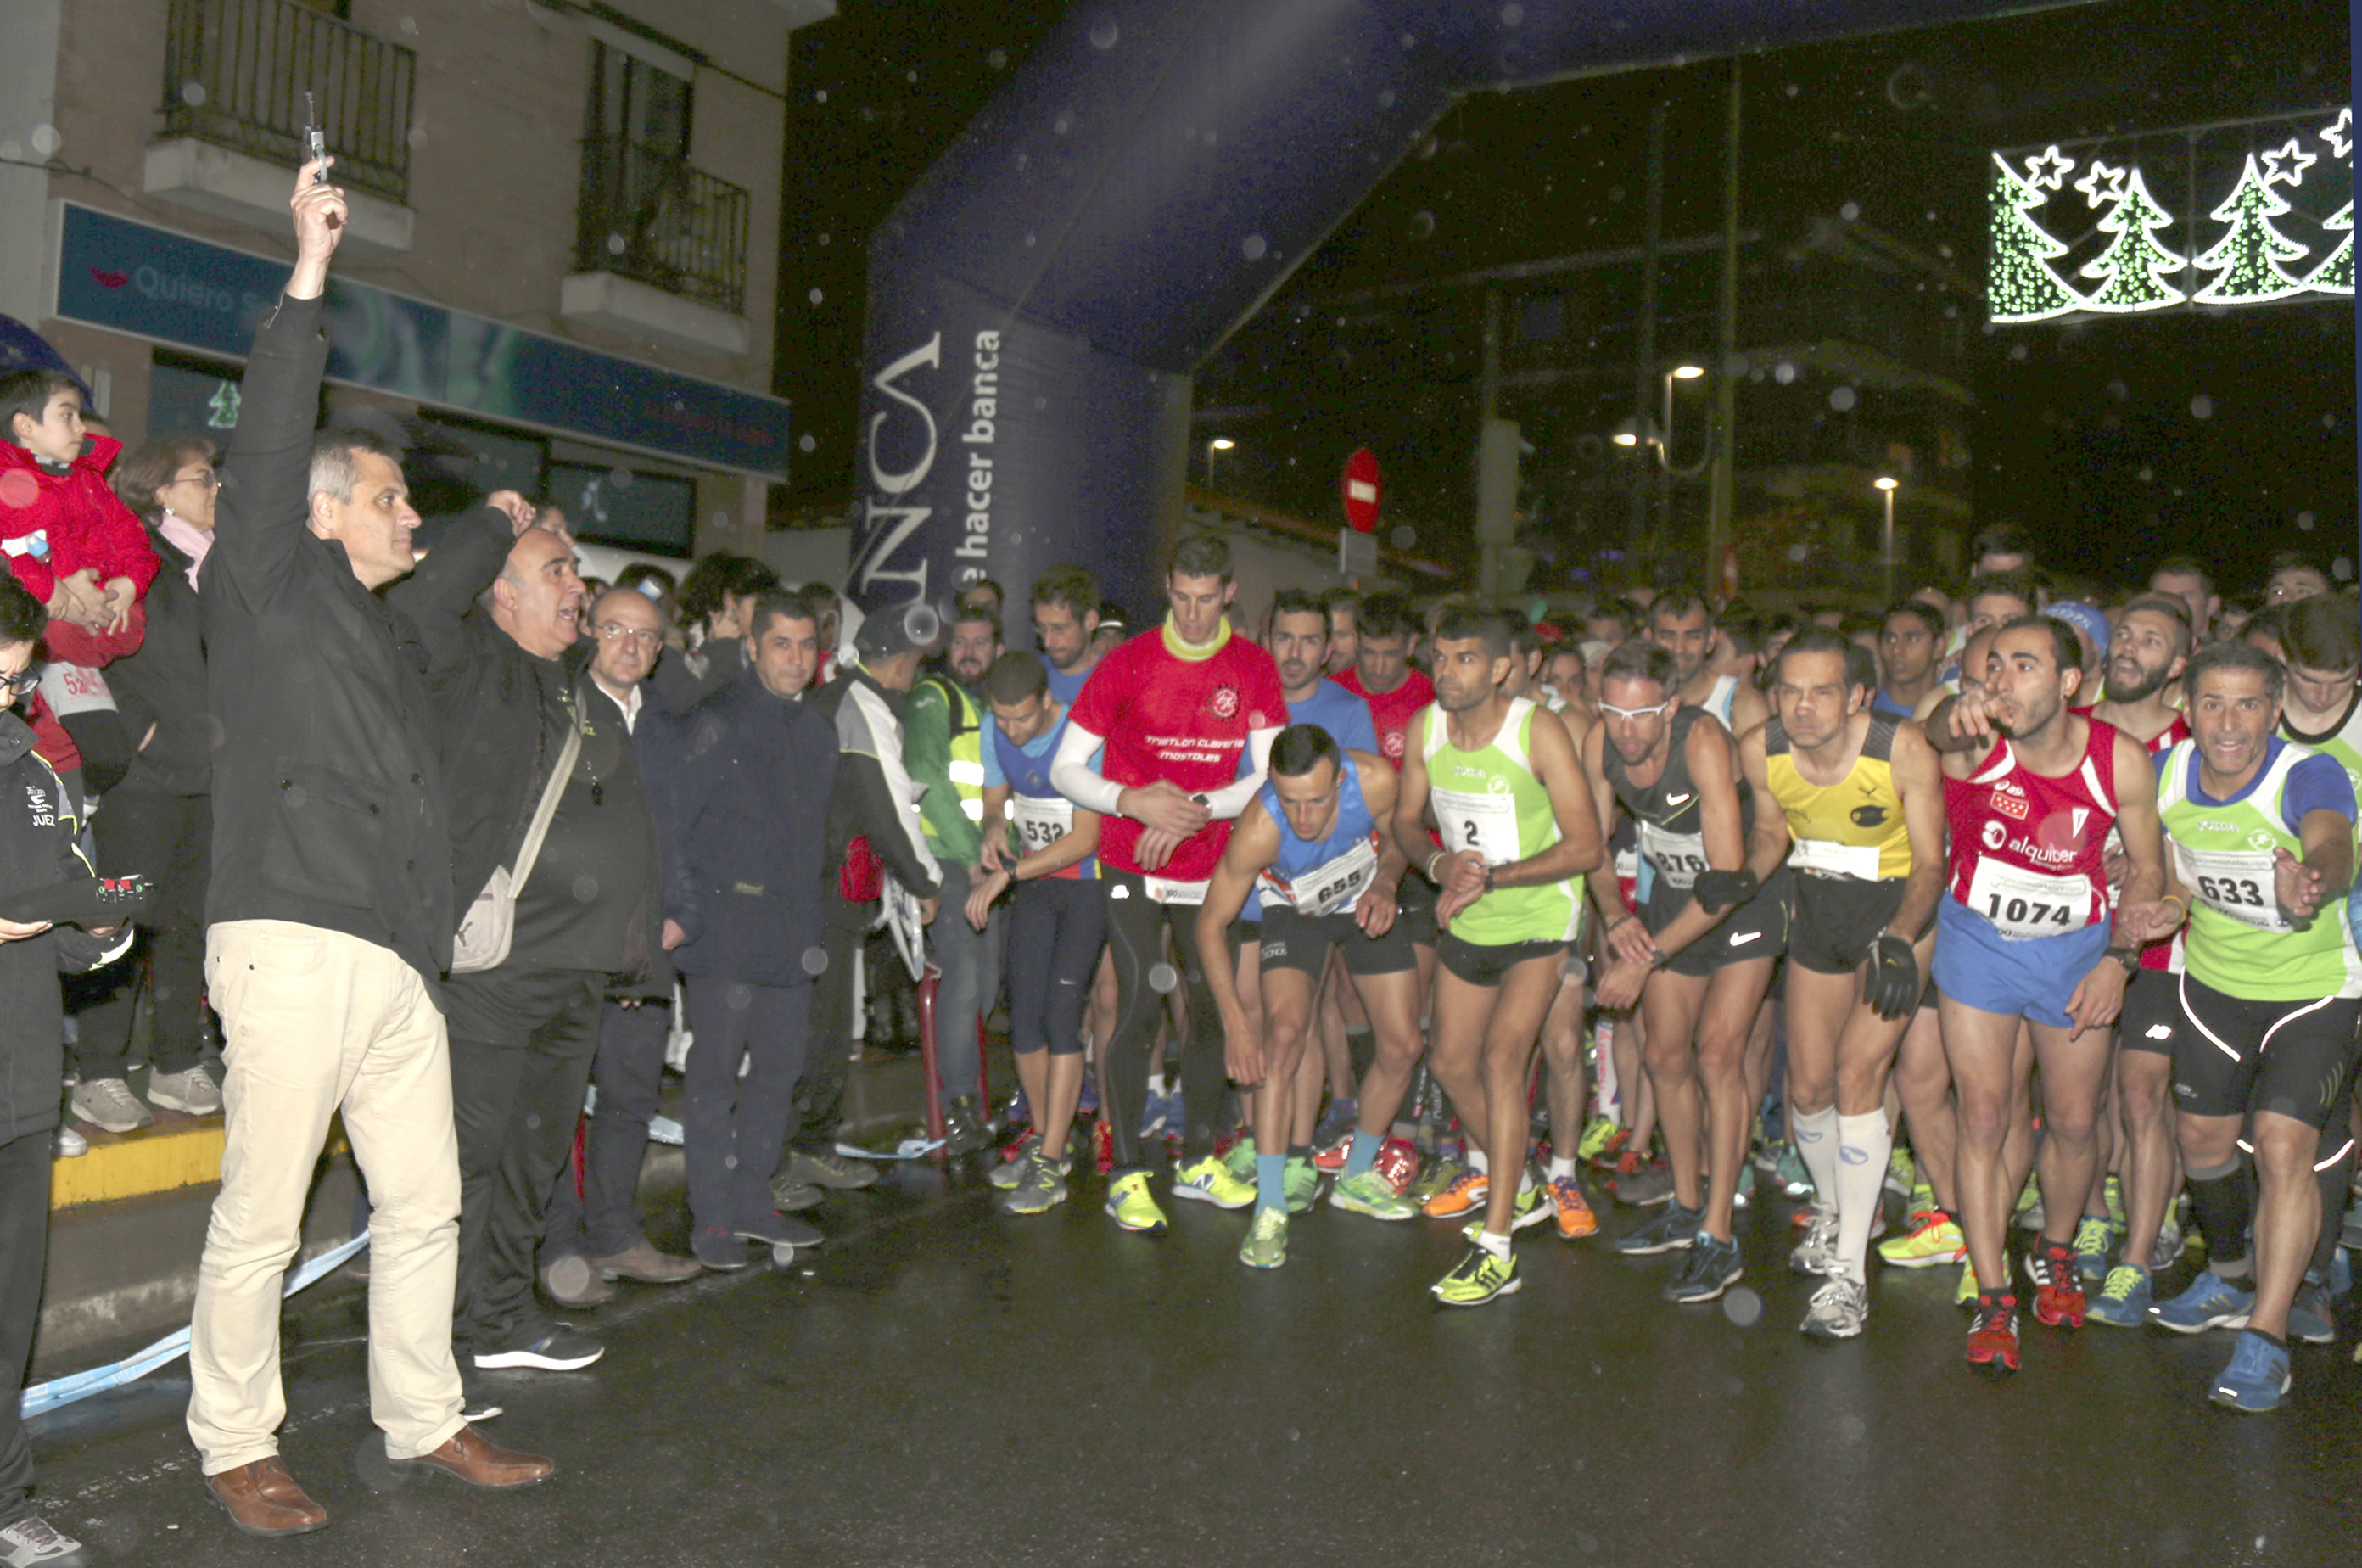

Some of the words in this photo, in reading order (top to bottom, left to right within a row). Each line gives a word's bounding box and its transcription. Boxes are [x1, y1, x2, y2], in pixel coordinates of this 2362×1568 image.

[134, 264, 234, 313] Quiero
[961, 330, 999, 443] banca
[955, 452, 993, 558] hacer
[1025, 820, 1066, 844] 532
[1464, 820, 1480, 847] 2
[1318, 868, 1362, 904] 655
[2197, 875, 2265, 908] 633
[1988, 893, 2072, 927] 1074
